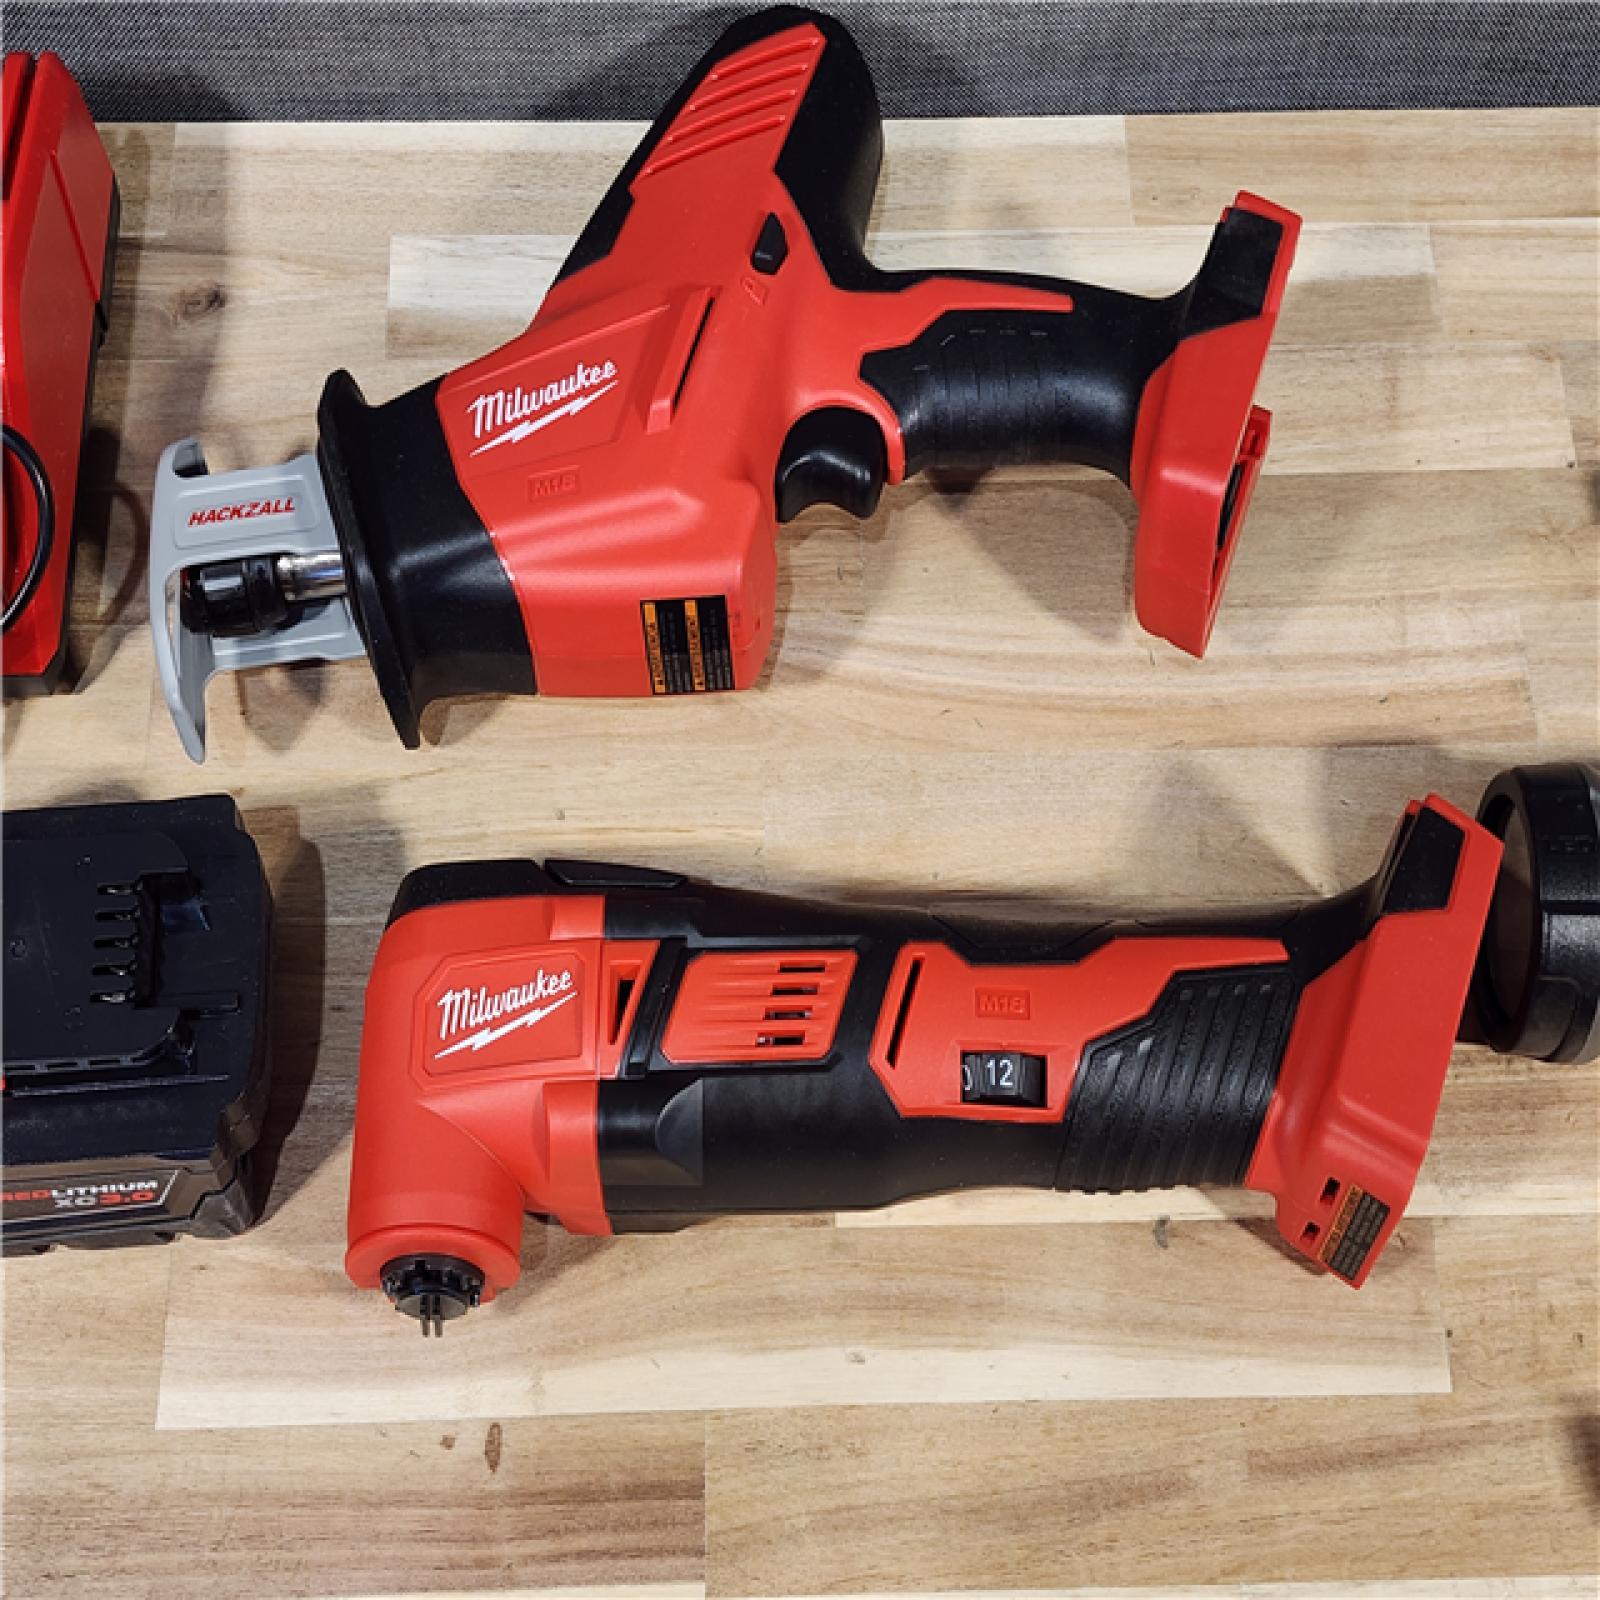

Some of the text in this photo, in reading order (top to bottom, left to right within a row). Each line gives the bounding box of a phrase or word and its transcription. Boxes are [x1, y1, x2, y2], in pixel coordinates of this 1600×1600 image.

[466, 359, 618, 439] Milwaukee
[187, 496, 296, 528] HACKZALL
[437, 968, 574, 1041] Milwaukee
[986, 1058, 1014, 1086] 12
